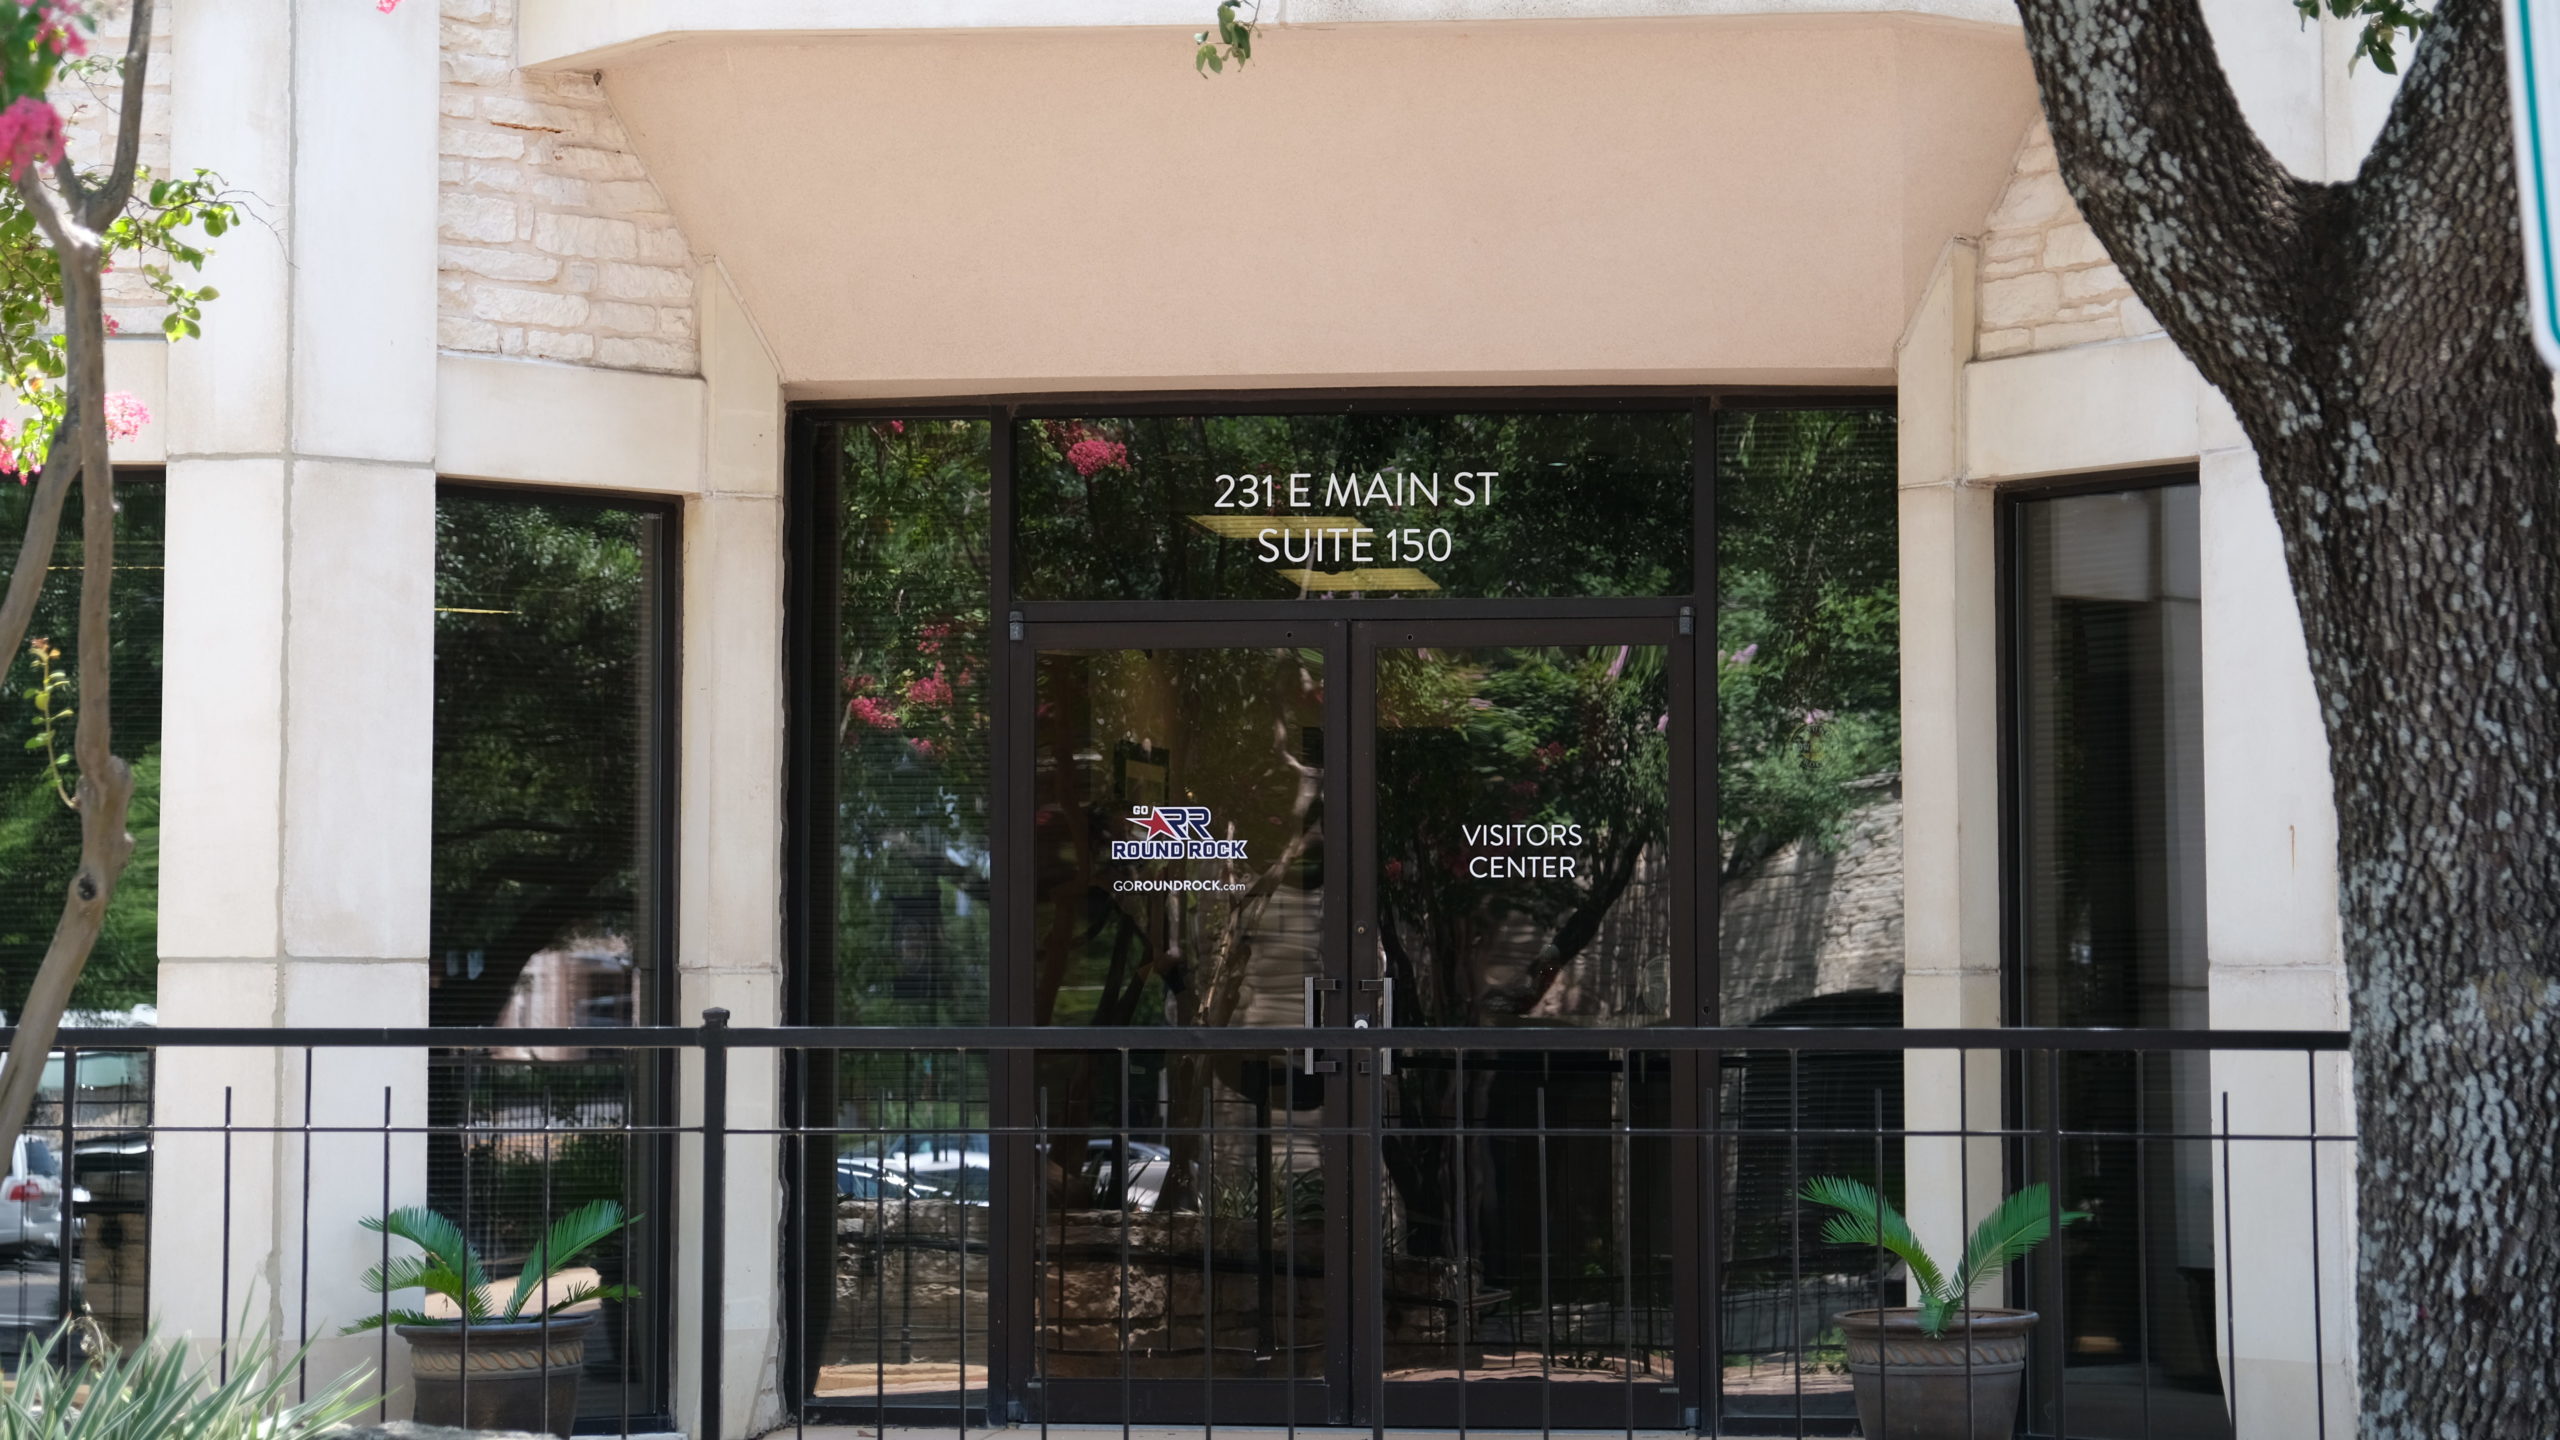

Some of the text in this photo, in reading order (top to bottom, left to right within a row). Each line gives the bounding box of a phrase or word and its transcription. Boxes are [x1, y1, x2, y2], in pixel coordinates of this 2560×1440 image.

[1214, 471, 1499, 508] 231 E MAIN ST
[1257, 527, 1452, 563] SUITE 150
[1132, 805, 1149, 815] GO
[1461, 824, 1583, 847] VISITORS
[1111, 840, 1248, 860] ROUND ROCK
[1469, 856, 1576, 878] CENTER
[1113, 880, 1246, 892] GOROUNDROCK.com
